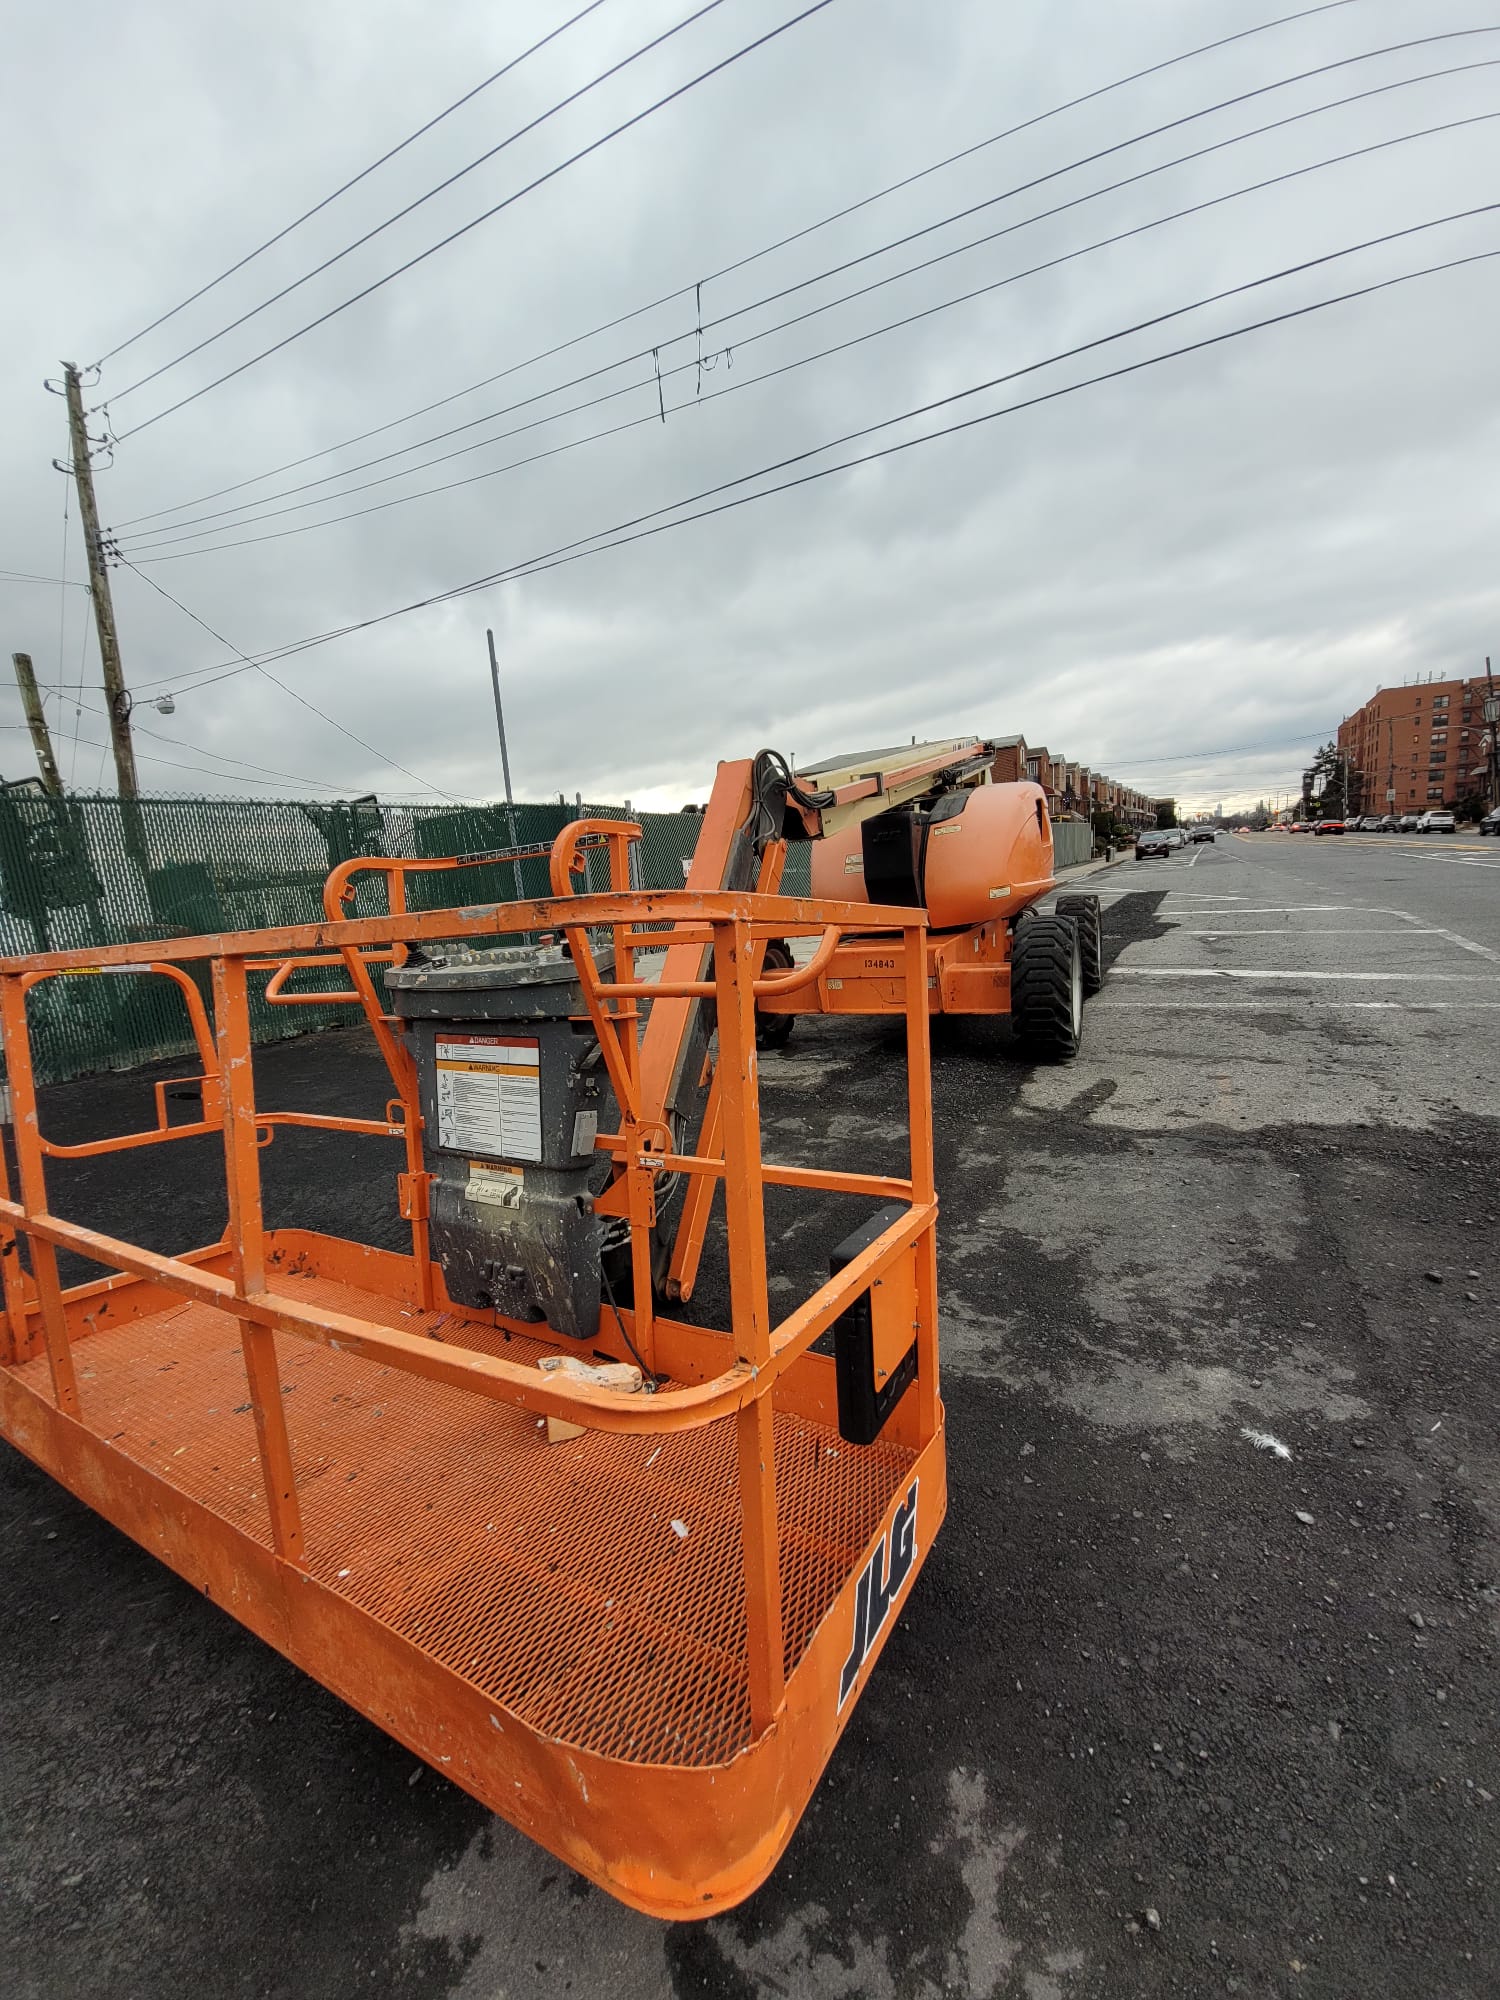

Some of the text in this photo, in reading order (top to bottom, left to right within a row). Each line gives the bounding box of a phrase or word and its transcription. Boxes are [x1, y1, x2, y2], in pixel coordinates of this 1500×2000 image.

[864, 959, 895, 969] 134843
[474, 1036, 499, 1045] DANGER
[473, 1063, 501, 1073] WARNING
[485, 1163, 513, 1174] WARNING
[837, 1475, 920, 1717] JLG
